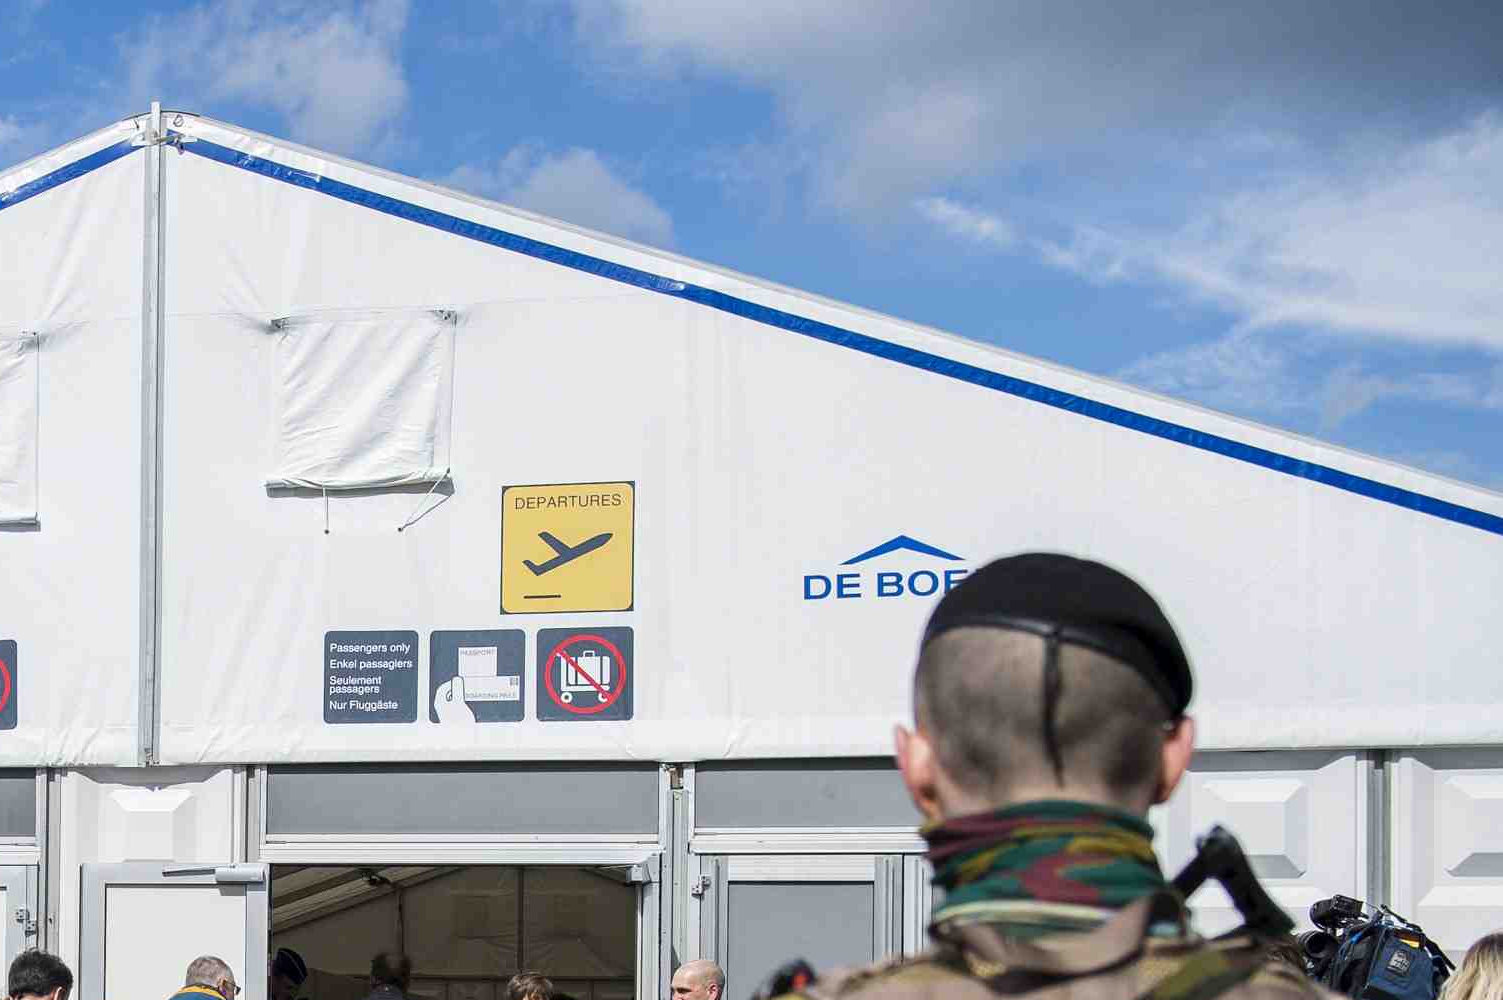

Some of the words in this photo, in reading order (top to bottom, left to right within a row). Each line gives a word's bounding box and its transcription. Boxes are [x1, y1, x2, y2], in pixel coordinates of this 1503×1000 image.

[514, 493, 622, 510] DEPARTURES
[803, 573, 862, 600] DE
[330, 643, 387, 655] Passengers
[390, 643, 411, 655] only
[330, 659, 357, 669] Enkel
[360, 659, 413, 671] passagiers
[330, 676, 382, 685] Seulement
[330, 686, 380, 696] passagers
[330, 700, 347, 710] Nur
[349, 700, 399, 712] Fluggäste
